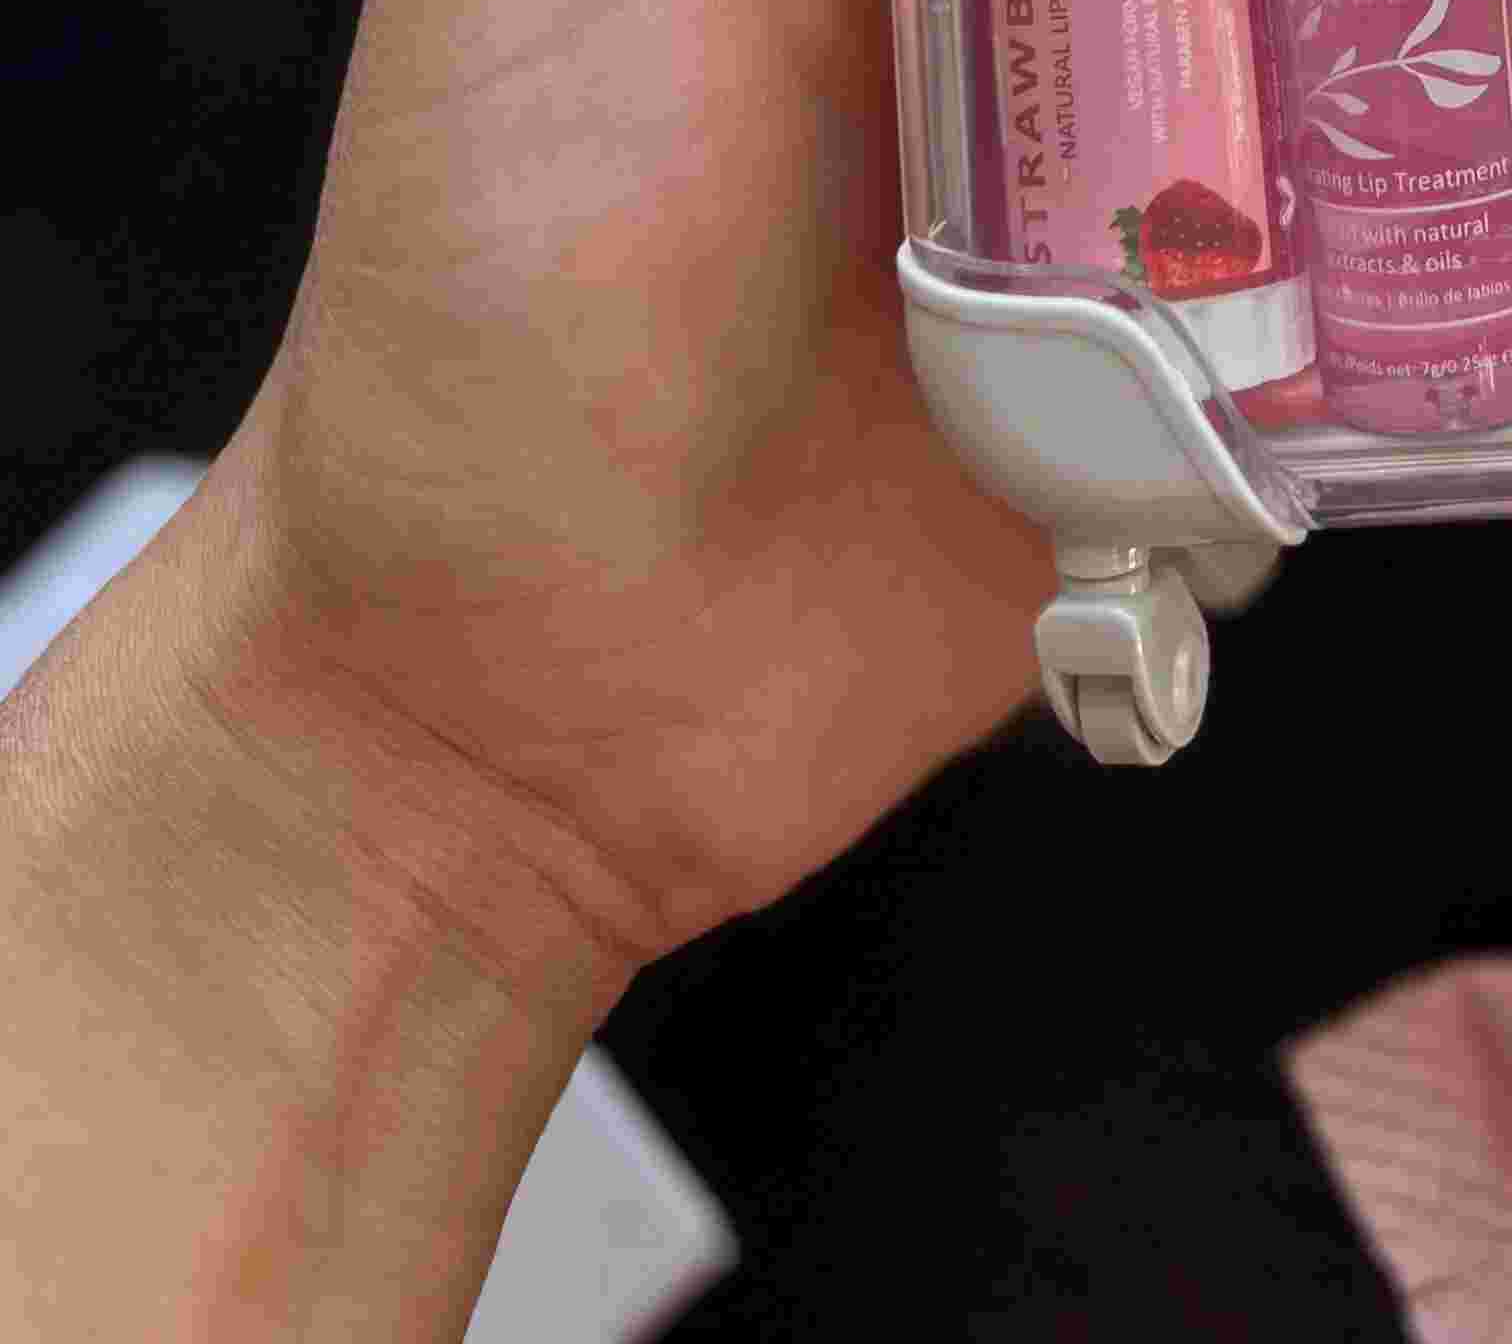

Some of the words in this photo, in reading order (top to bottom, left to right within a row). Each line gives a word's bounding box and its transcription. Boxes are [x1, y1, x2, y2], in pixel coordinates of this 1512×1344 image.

[1052, 42, 1078, 162] NATURAL
[1357, 170, 1389, 200] Lip
[1392, 154, 1511, 195] Treatment
[1361, 220, 1408, 247] with
[1413, 210, 1491, 244] natural
[1332, 244, 1395, 276] tracts
[1400, 250, 1421, 274] &
[1424, 248, 1465, 273] oils
[1443, 285, 1465, 305] de
